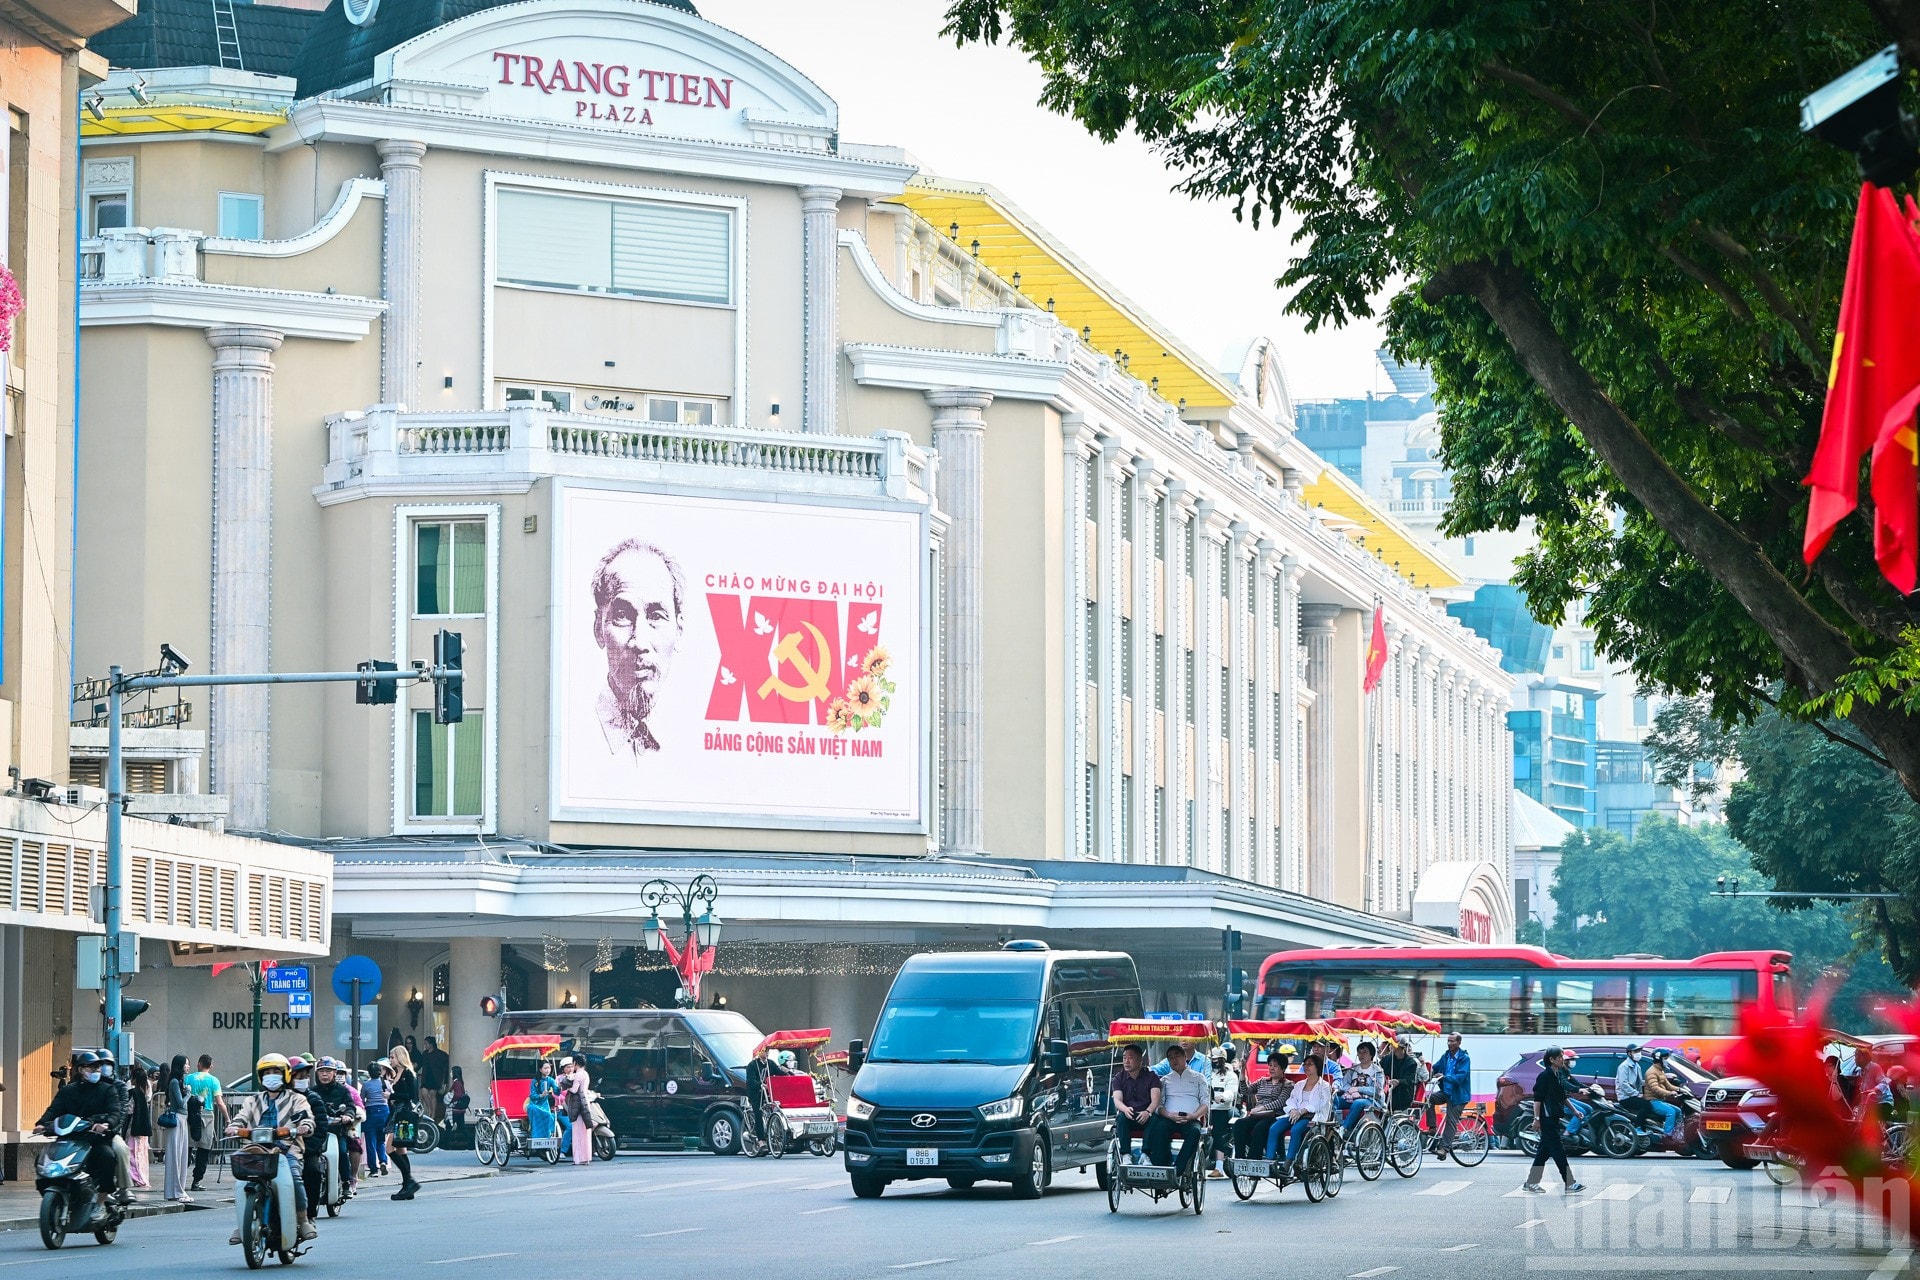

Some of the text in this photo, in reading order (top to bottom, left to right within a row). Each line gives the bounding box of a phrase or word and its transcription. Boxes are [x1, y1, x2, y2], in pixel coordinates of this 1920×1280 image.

[494, 52, 734, 109] TRANG TIEN
[576, 100, 654, 125] PLAZA
[705, 572, 884, 601] CHÀO MỪNG ĐẠI HỘI
[703, 727, 883, 760] ĐẢNG CỘNG SẢN VIỆT NAM
[270, 978, 290, 989] TRÀNG
[910, 1157, 934, 1165] 018.31
[915, 1149, 930, 1157] 88B
